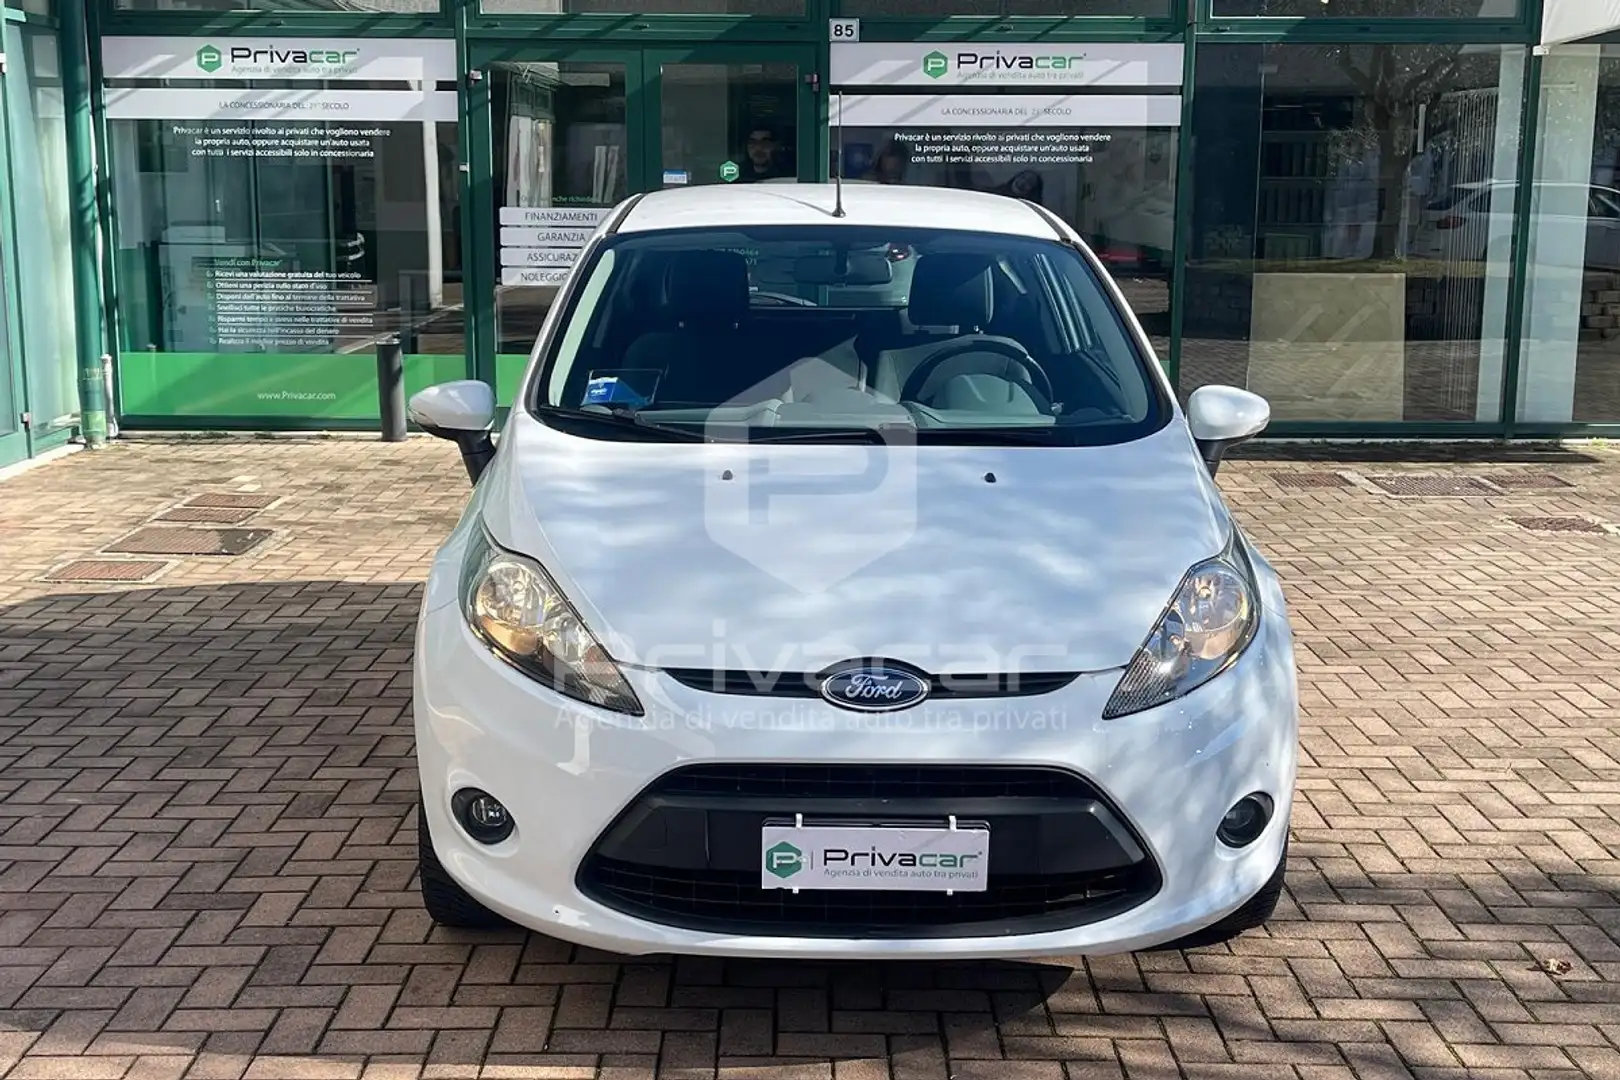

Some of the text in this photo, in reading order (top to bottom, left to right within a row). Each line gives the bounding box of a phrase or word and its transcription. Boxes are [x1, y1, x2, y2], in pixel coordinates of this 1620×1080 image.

[834, 24, 854, 37] 85
[231, 45, 357, 63] Privacar
[957, 50, 1083, 69] Privacar
[219, 101, 228, 110] LA
[229, 101, 292, 110] CONCESSIONARIA
[292, 101, 305, 110] DEL
[321, 101, 350, 110] SECOLO
[941, 108, 951, 116] LA
[952, 108, 1014, 116] CONCESSIONARIA
[1014, 108, 1028, 116] DEL
[1043, 108, 1072, 116] SECOLO
[173, 126, 203, 135] Privacar
[204, 126, 209, 135] è
[222, 126, 251, 135] servizio
[252, 126, 277, 135] rivolto
[277, 126, 284, 135] ai
[285, 126, 309, 137] privati
[310, 126, 324, 135] che
[325, 126, 359, 137] vogliono
[359, 126, 391, 135] vendere
[194, 137, 370, 147] la propria auto, oppure acquistare un'auto usata
[894, 132, 924, 141] Privacar
[925, 132, 930, 141] è
[943, 132, 972, 141] servizio
[972, 132, 997, 141] rivolto
[998, 132, 1005, 141] ai
[1006, 132, 1030, 142] privati
[1031, 132, 1045, 141] che
[1046, 132, 1080, 143] vogliono
[1080, 132, 1111, 141] vendere
[191, 149, 206, 157] con
[207, 149, 224, 157] tutti
[230, 149, 254, 157] servizi
[255, 149, 293, 157] accessibili
[294, 149, 310, 157] solo
[310, 149, 319, 157] in
[319, 149, 374, 157] concessionaria
[915, 144, 1090, 153] la propria auto, oppure acquistare un'auto usata
[911, 154, 926, 163] con
[926, 154, 943, 163] tutti
[949, 154, 973, 163] servizi
[974, 154, 1012, 163] accessibili
[1012, 154, 1029, 163] solo
[1030, 154, 1038, 163] in
[1038, 154, 1094, 163] concessionaria
[525, 211, 598, 221] FINANZIAMENTI
[537, 232, 586, 242] GARANZIA
[527, 252, 578, 262] ASSICURAZ
[844, 673, 903, 698] Ford
[823, 846, 978, 868] Privacar
[824, 869, 979, 879] Agenzia di vendita auto tra privati
